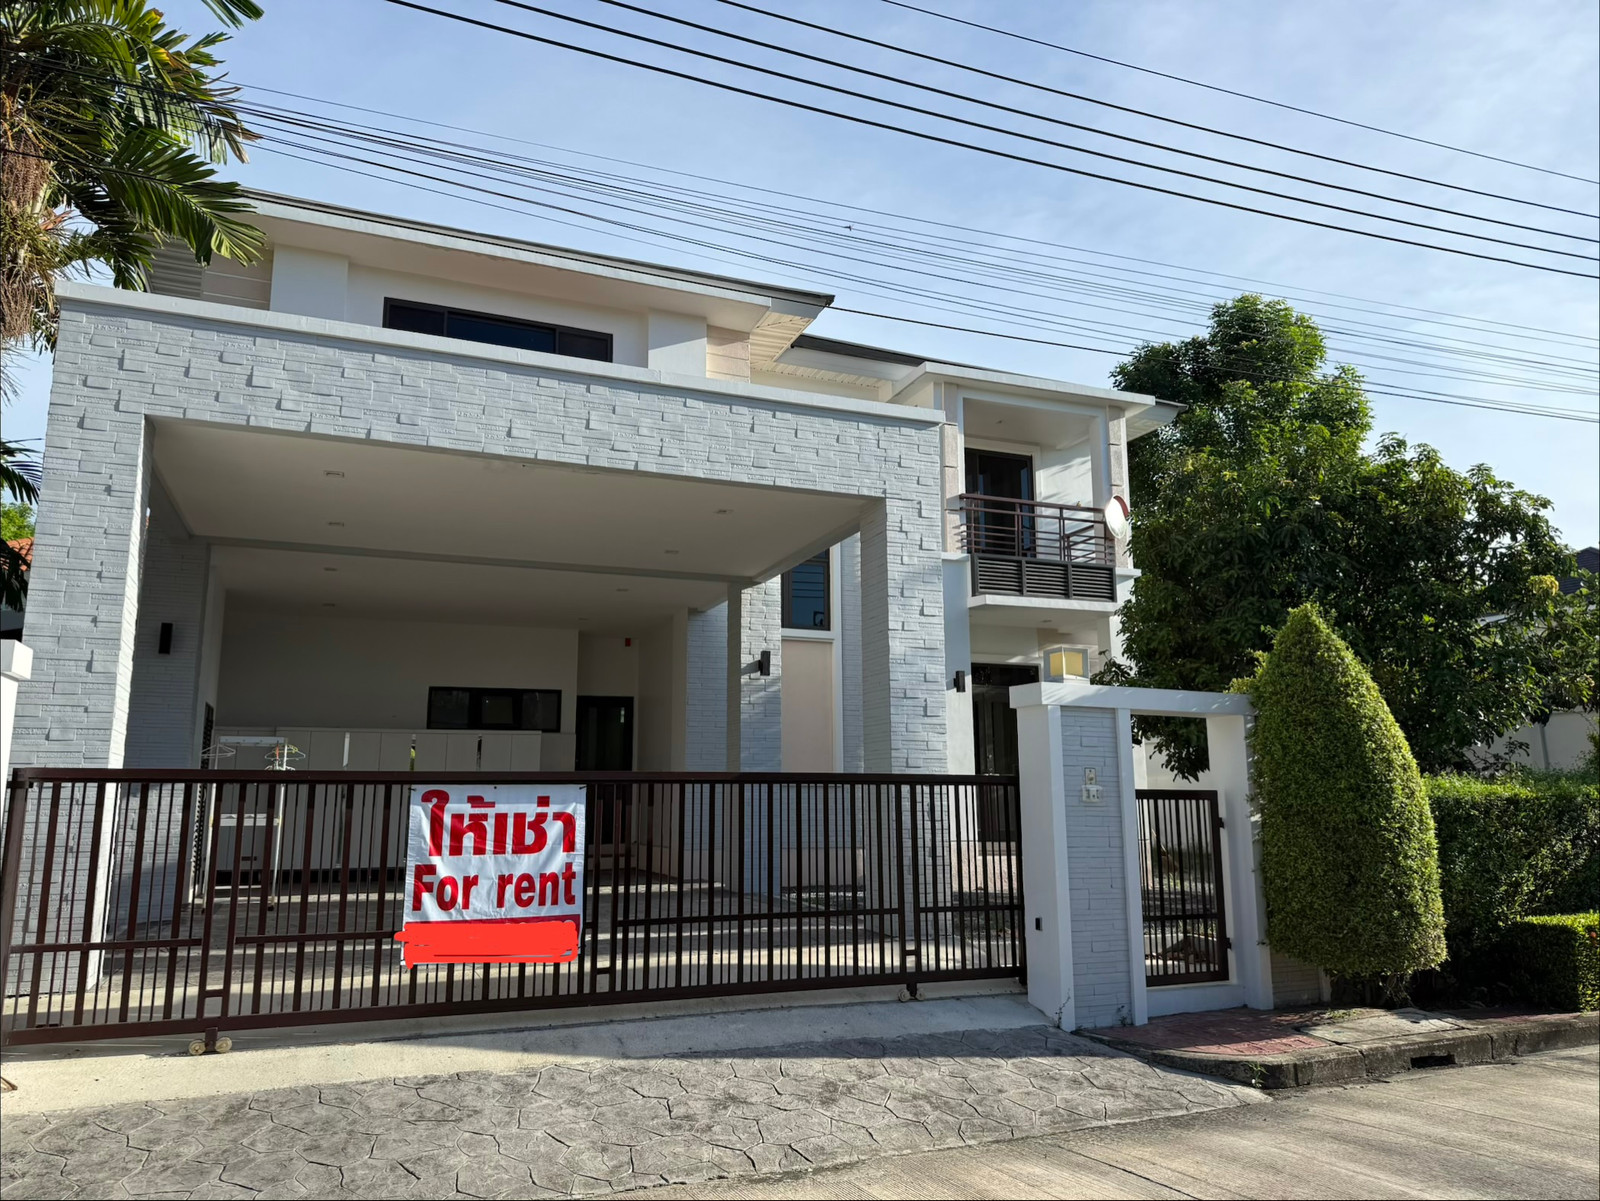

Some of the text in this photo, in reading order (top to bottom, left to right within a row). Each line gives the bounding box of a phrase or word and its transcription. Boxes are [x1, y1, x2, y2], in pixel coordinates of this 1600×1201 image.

[421, 789, 576, 856] ให้เช่า
[412, 862, 576, 911] For rent
